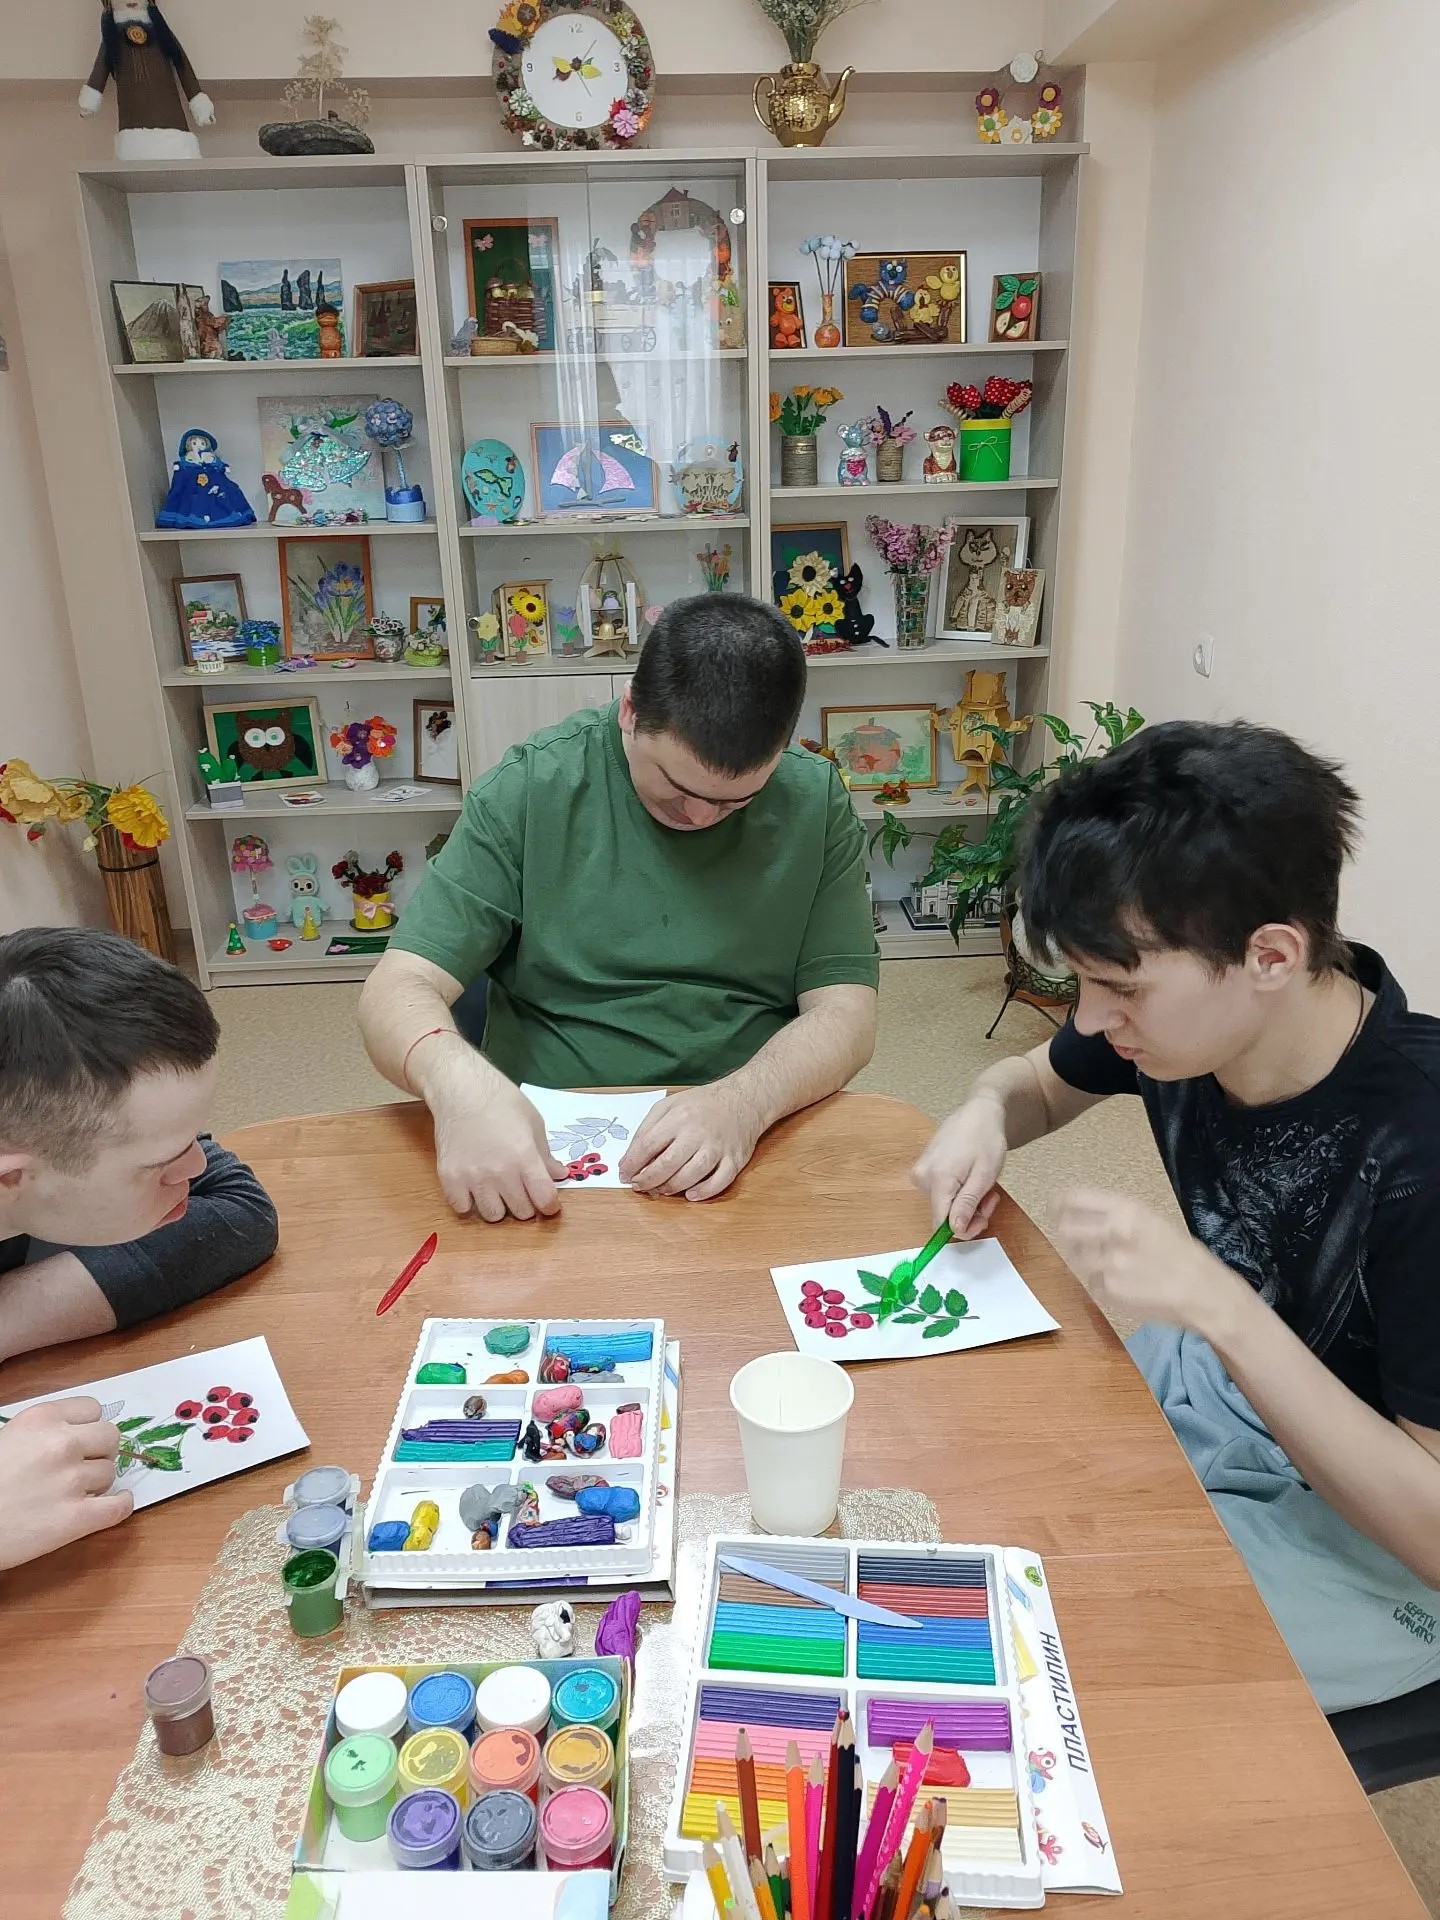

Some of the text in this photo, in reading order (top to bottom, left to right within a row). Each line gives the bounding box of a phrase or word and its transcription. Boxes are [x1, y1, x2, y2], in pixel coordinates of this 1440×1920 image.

[568, 23, 583, 34] 12
[526, 62, 534, 73] 9
[613, 62, 621, 73] 3
[575, 111, 583, 121] 6
[1039, 1630, 1089, 1773] ПЛАСТИЛИН
